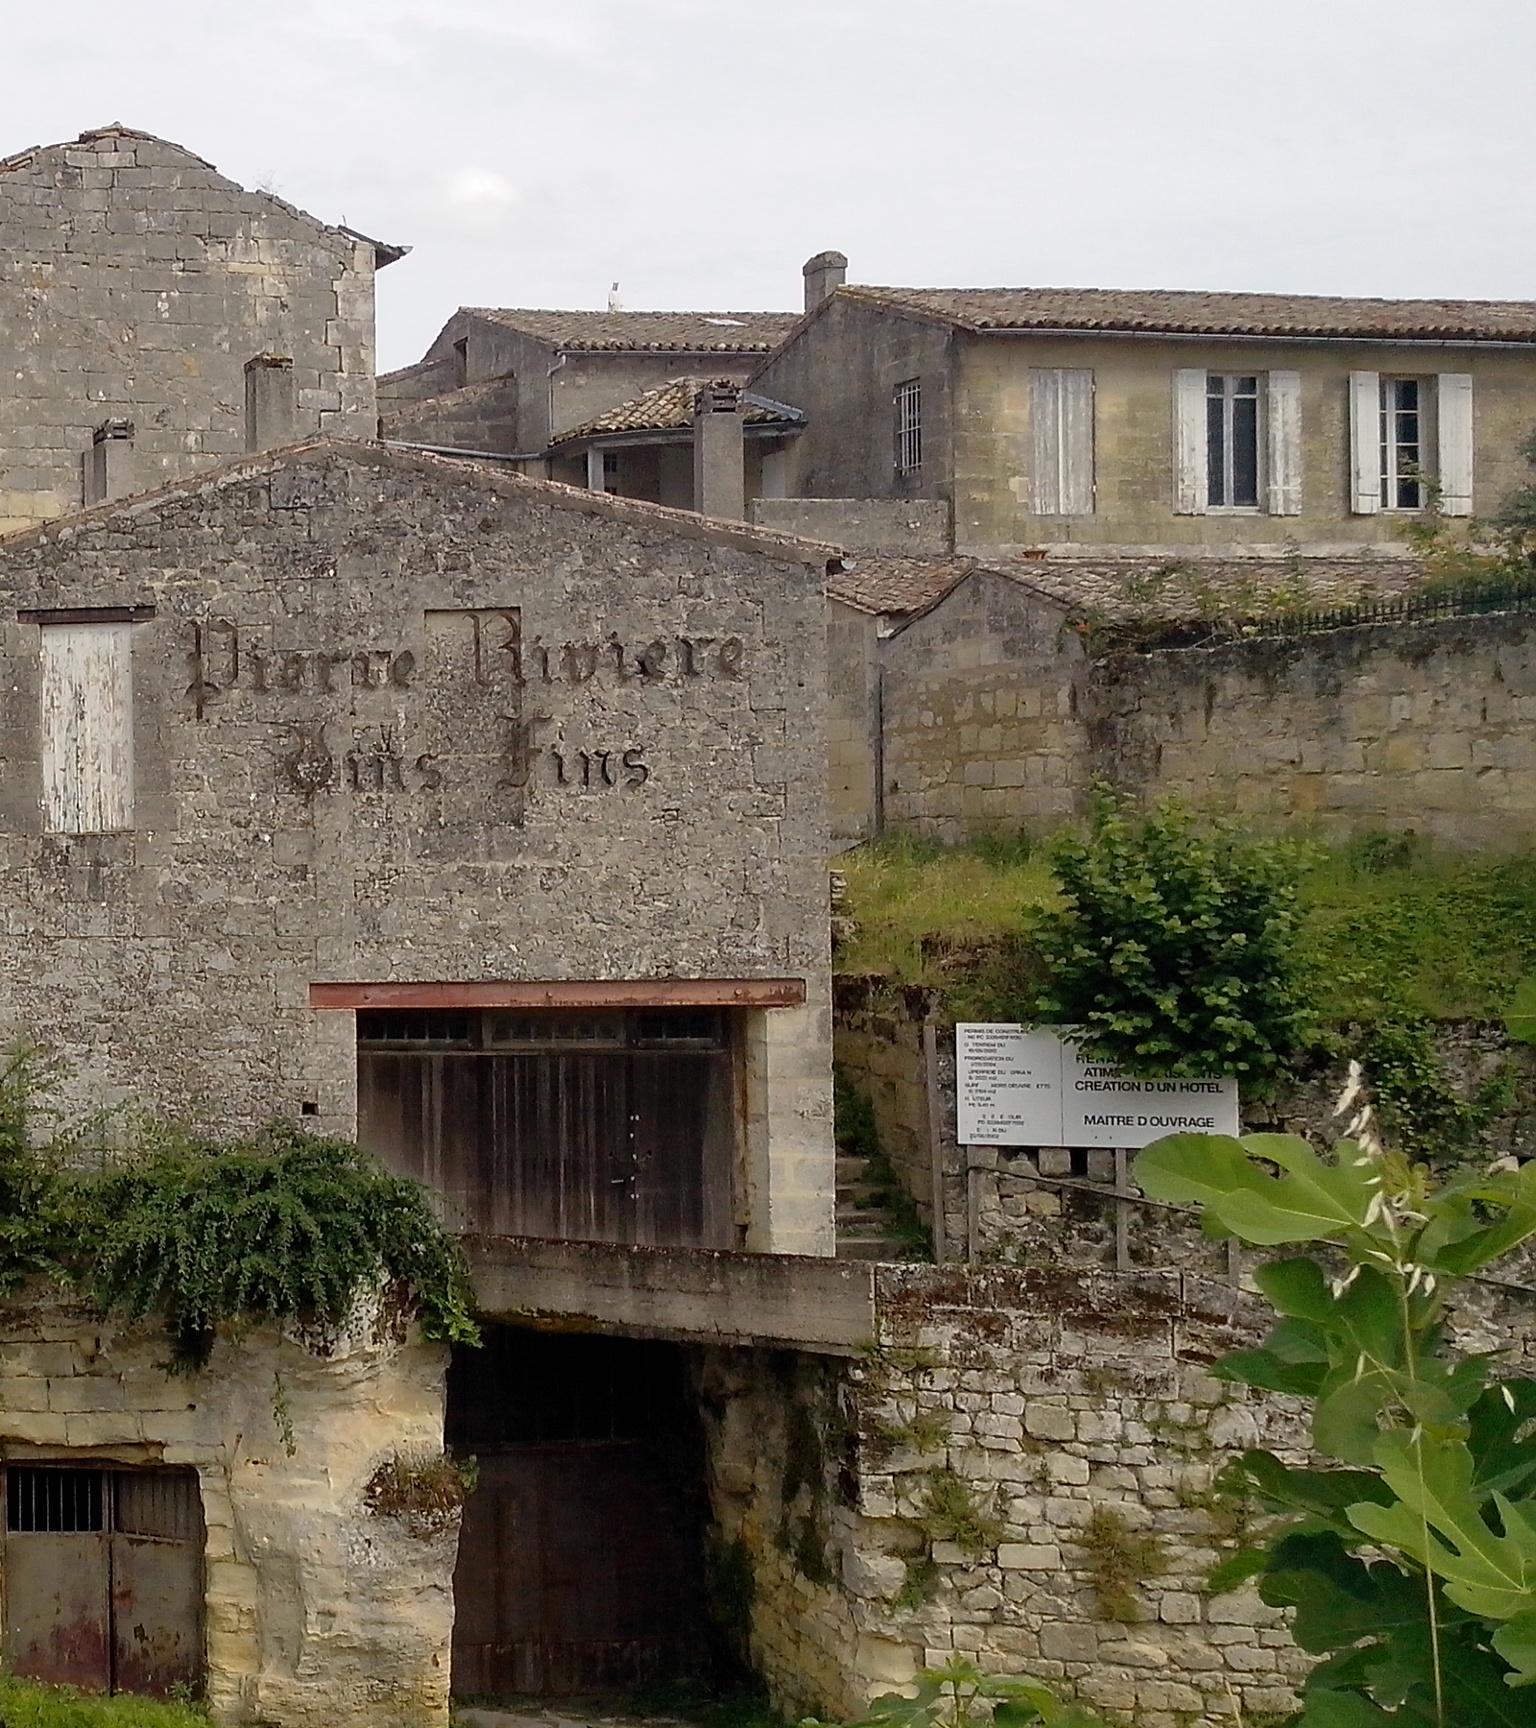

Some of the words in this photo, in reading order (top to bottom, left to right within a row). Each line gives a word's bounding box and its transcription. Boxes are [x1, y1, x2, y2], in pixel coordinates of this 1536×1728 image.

[183, 612, 416, 721] Pierre
[1074, 1080, 1141, 1092] CREATION
[1180, 1082, 1224, 1093] HOTEL
[1084, 1114, 1135, 1126] MAITRE
[1149, 1116, 1215, 1128] OUVRAGE
